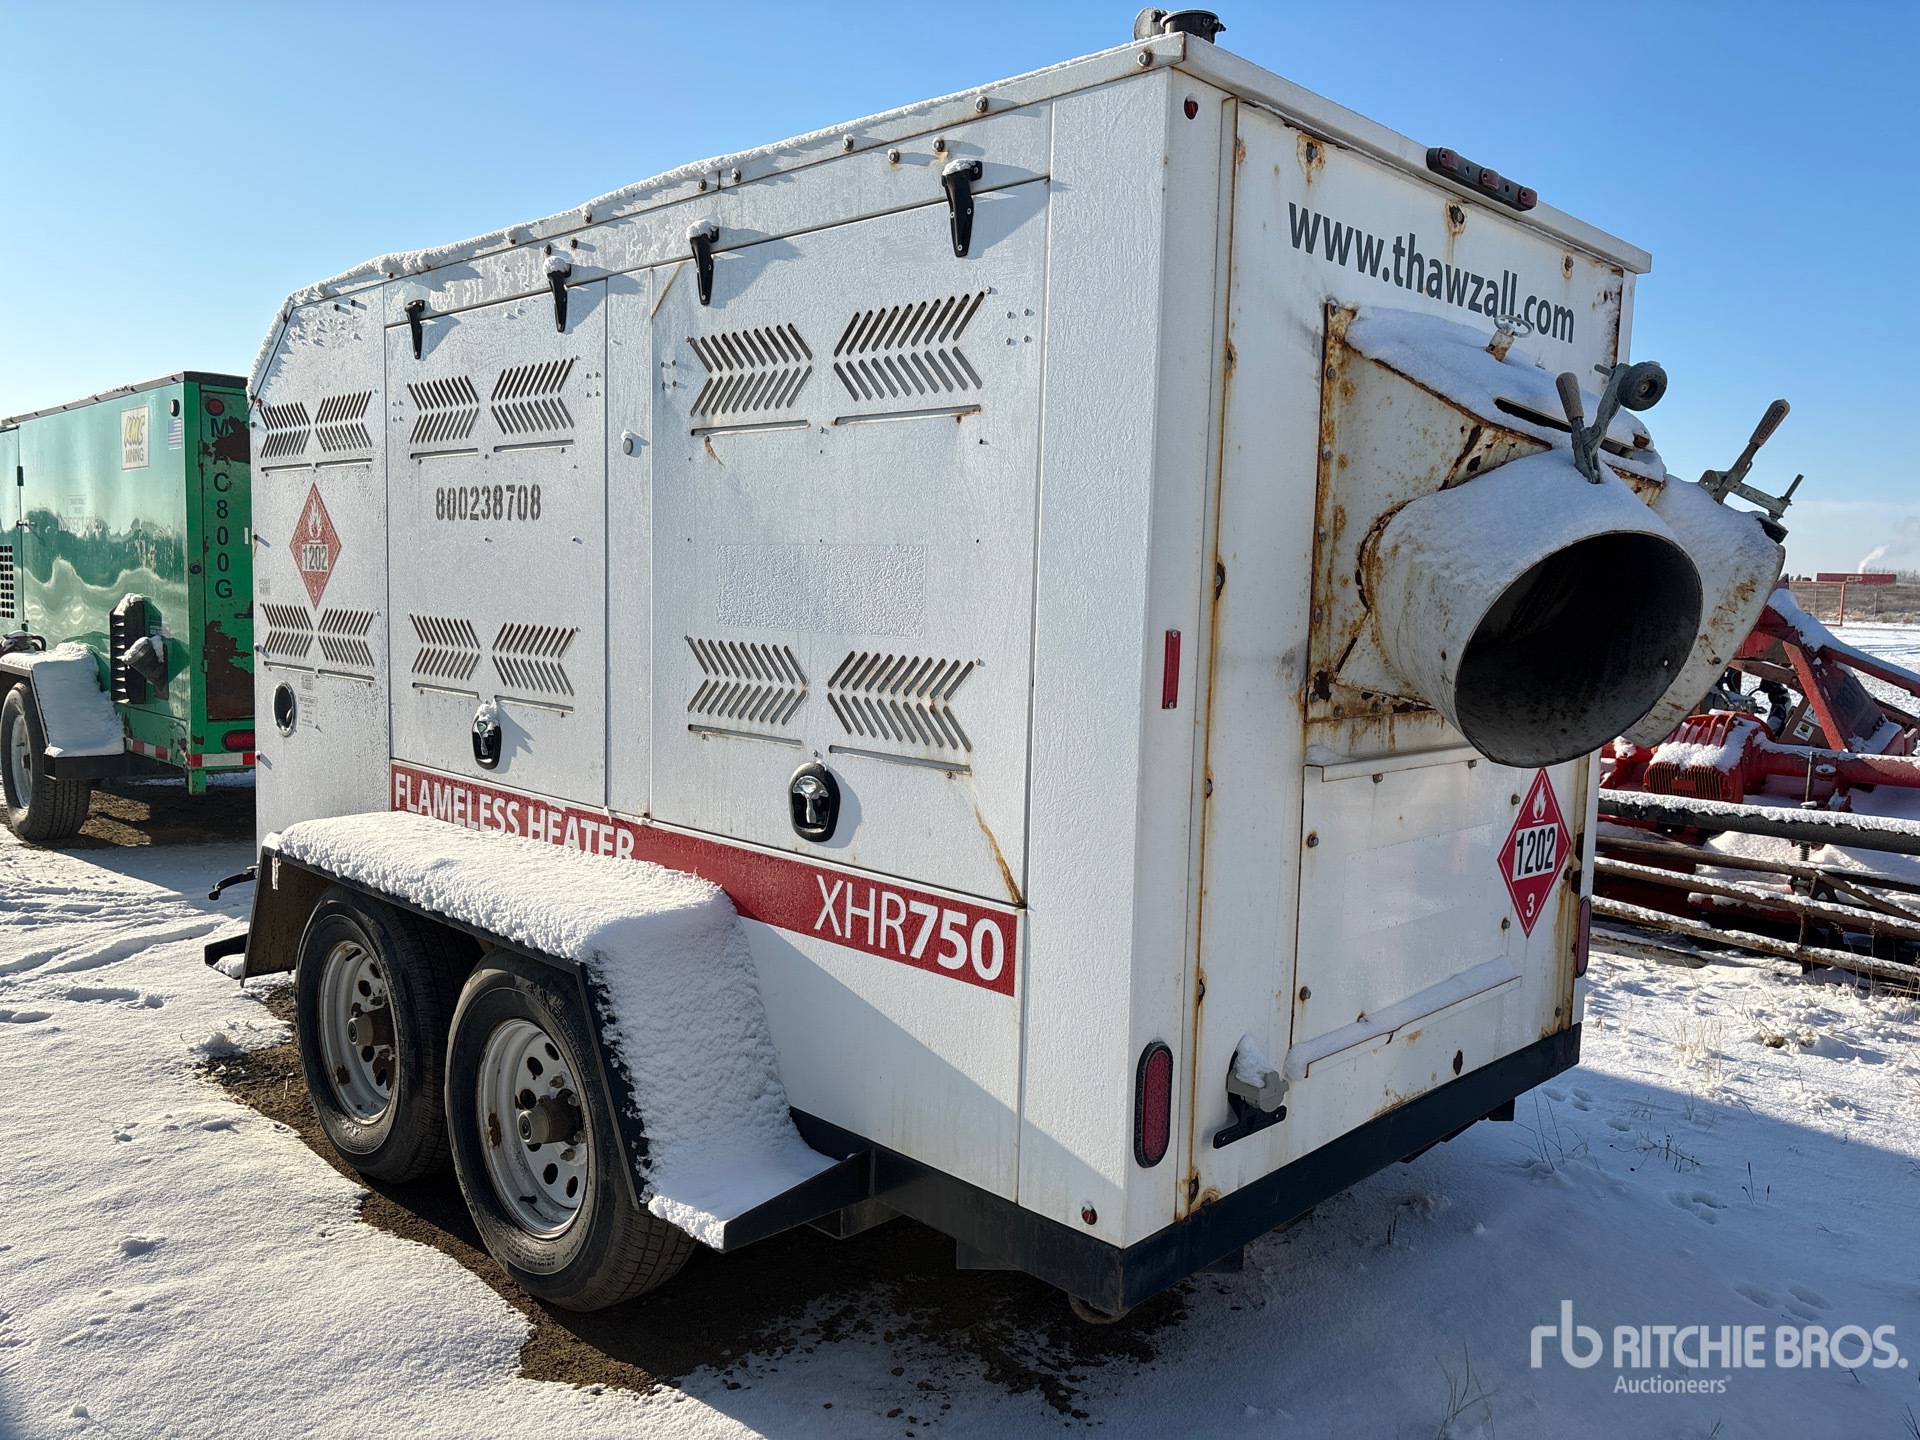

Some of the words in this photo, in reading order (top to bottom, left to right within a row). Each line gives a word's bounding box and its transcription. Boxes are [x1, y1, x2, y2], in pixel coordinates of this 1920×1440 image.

[1288, 201, 1575, 344] www.thawzall.com
[435, 484, 541, 521] 800238708
[303, 544, 327, 570] 1202
[395, 773, 521, 837] FLAMELESS
[527, 805, 635, 860] HEATER
[1516, 826, 1556, 876] 1202
[813, 874, 1005, 981] XHR750
[1526, 892, 1535, 918] 3
